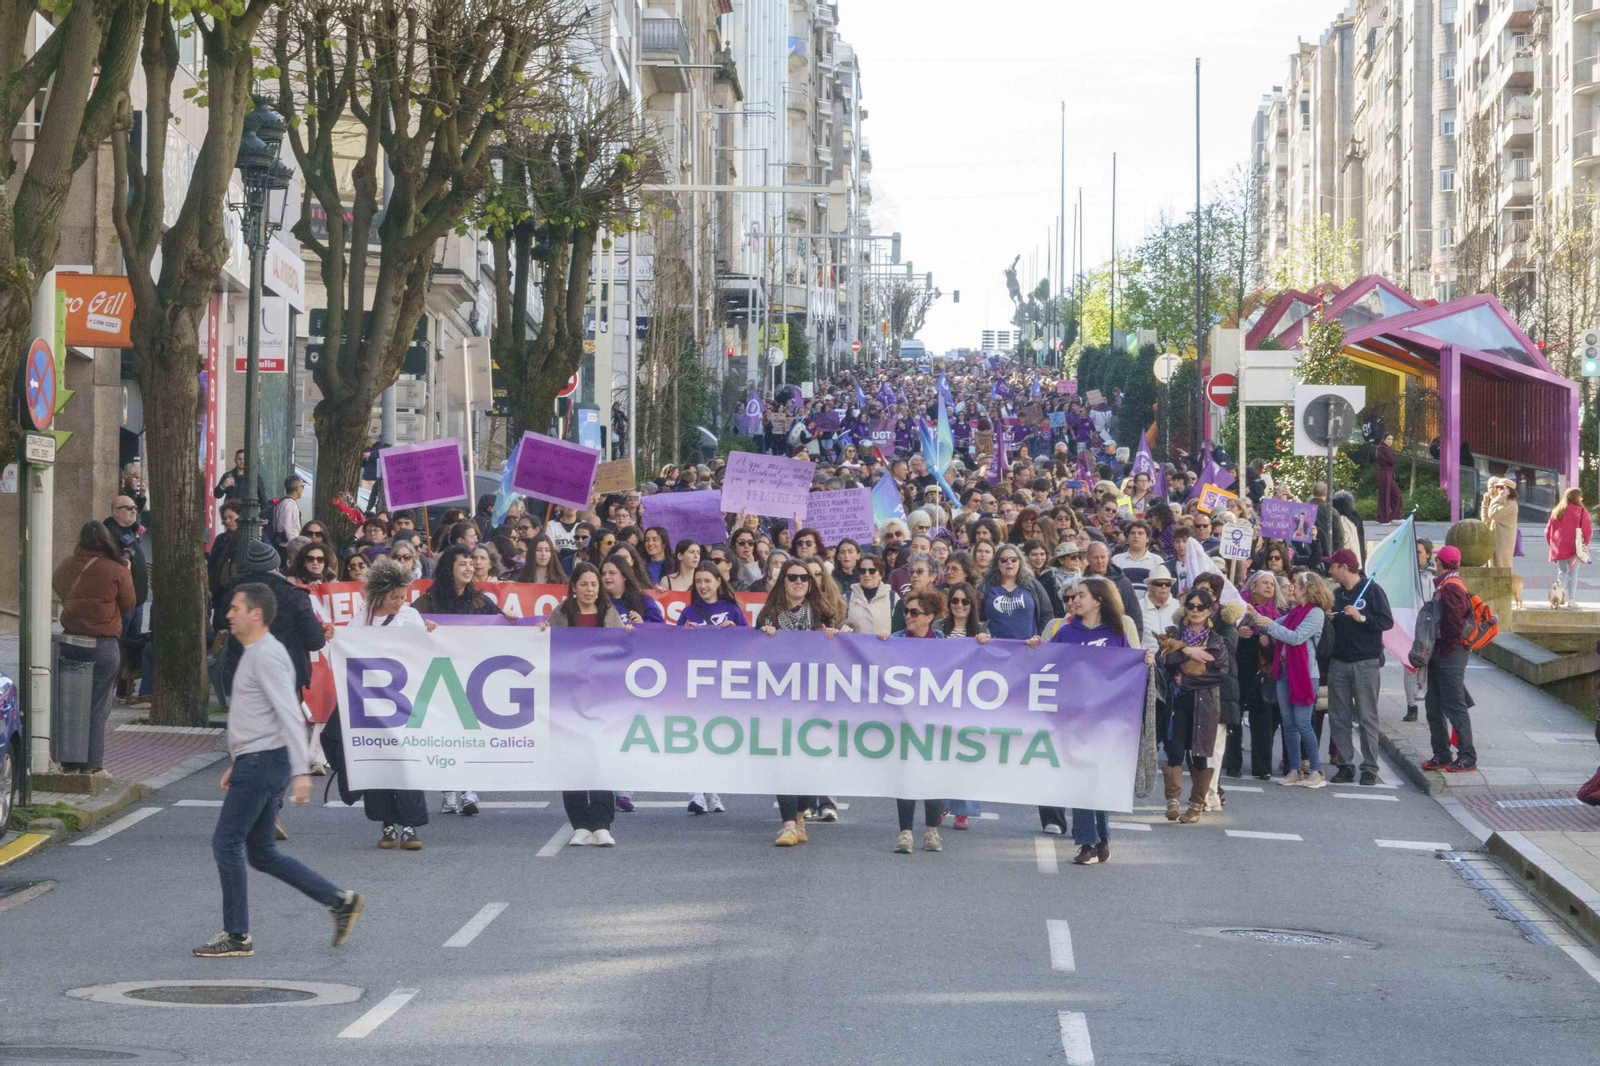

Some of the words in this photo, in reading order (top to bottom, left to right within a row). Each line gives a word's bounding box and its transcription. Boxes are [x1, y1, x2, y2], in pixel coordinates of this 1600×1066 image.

[88, 291, 127, 315] Gill
[208, 315, 217, 529] REBAJAS
[872, 431, 891, 440] UGT
[624, 658, 667, 699] O
[686, 659, 1009, 711] FEMINISMO
[1028, 662, 1060, 712] É
[351, 735, 399, 749] Bloque
[401, 734, 486, 749] Abolicionista
[489, 736, 535, 749] Galicia
[619, 713, 1061, 768] ABOLICIONISTA
[426, 754, 456, 769] Vigo
